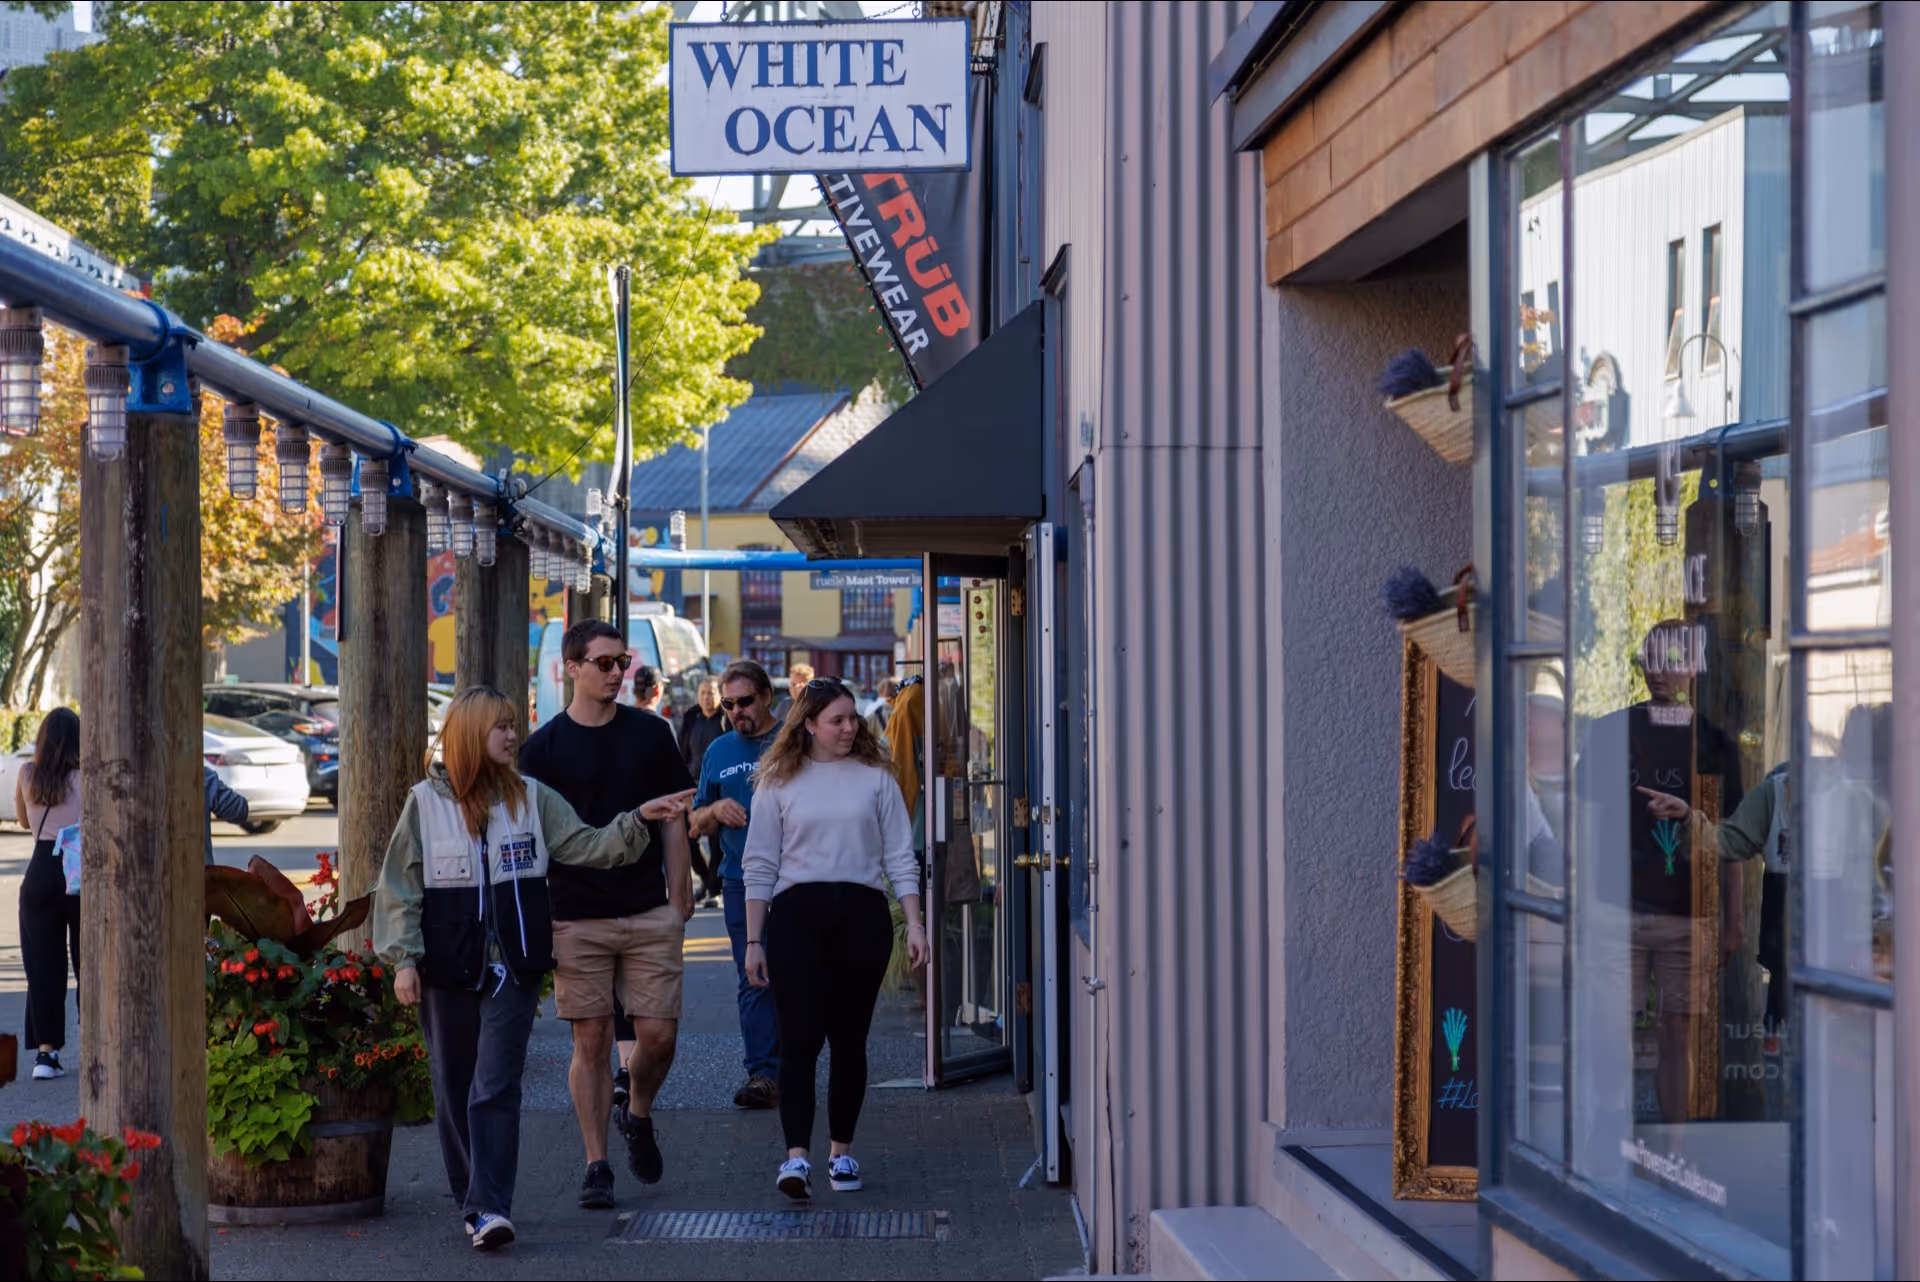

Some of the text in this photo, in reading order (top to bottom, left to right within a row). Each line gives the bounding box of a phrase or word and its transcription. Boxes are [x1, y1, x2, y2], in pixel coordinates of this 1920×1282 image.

[686, 38, 907, 91] WHITE
[724, 103, 952, 156] OCEAN
[824, 173, 929, 356] TIVEWEAR
[815, 574, 844, 587] ruelle
[846, 575, 874, 586] Mast
[876, 574, 911, 586] Tower
[719, 760, 761, 779] carha
